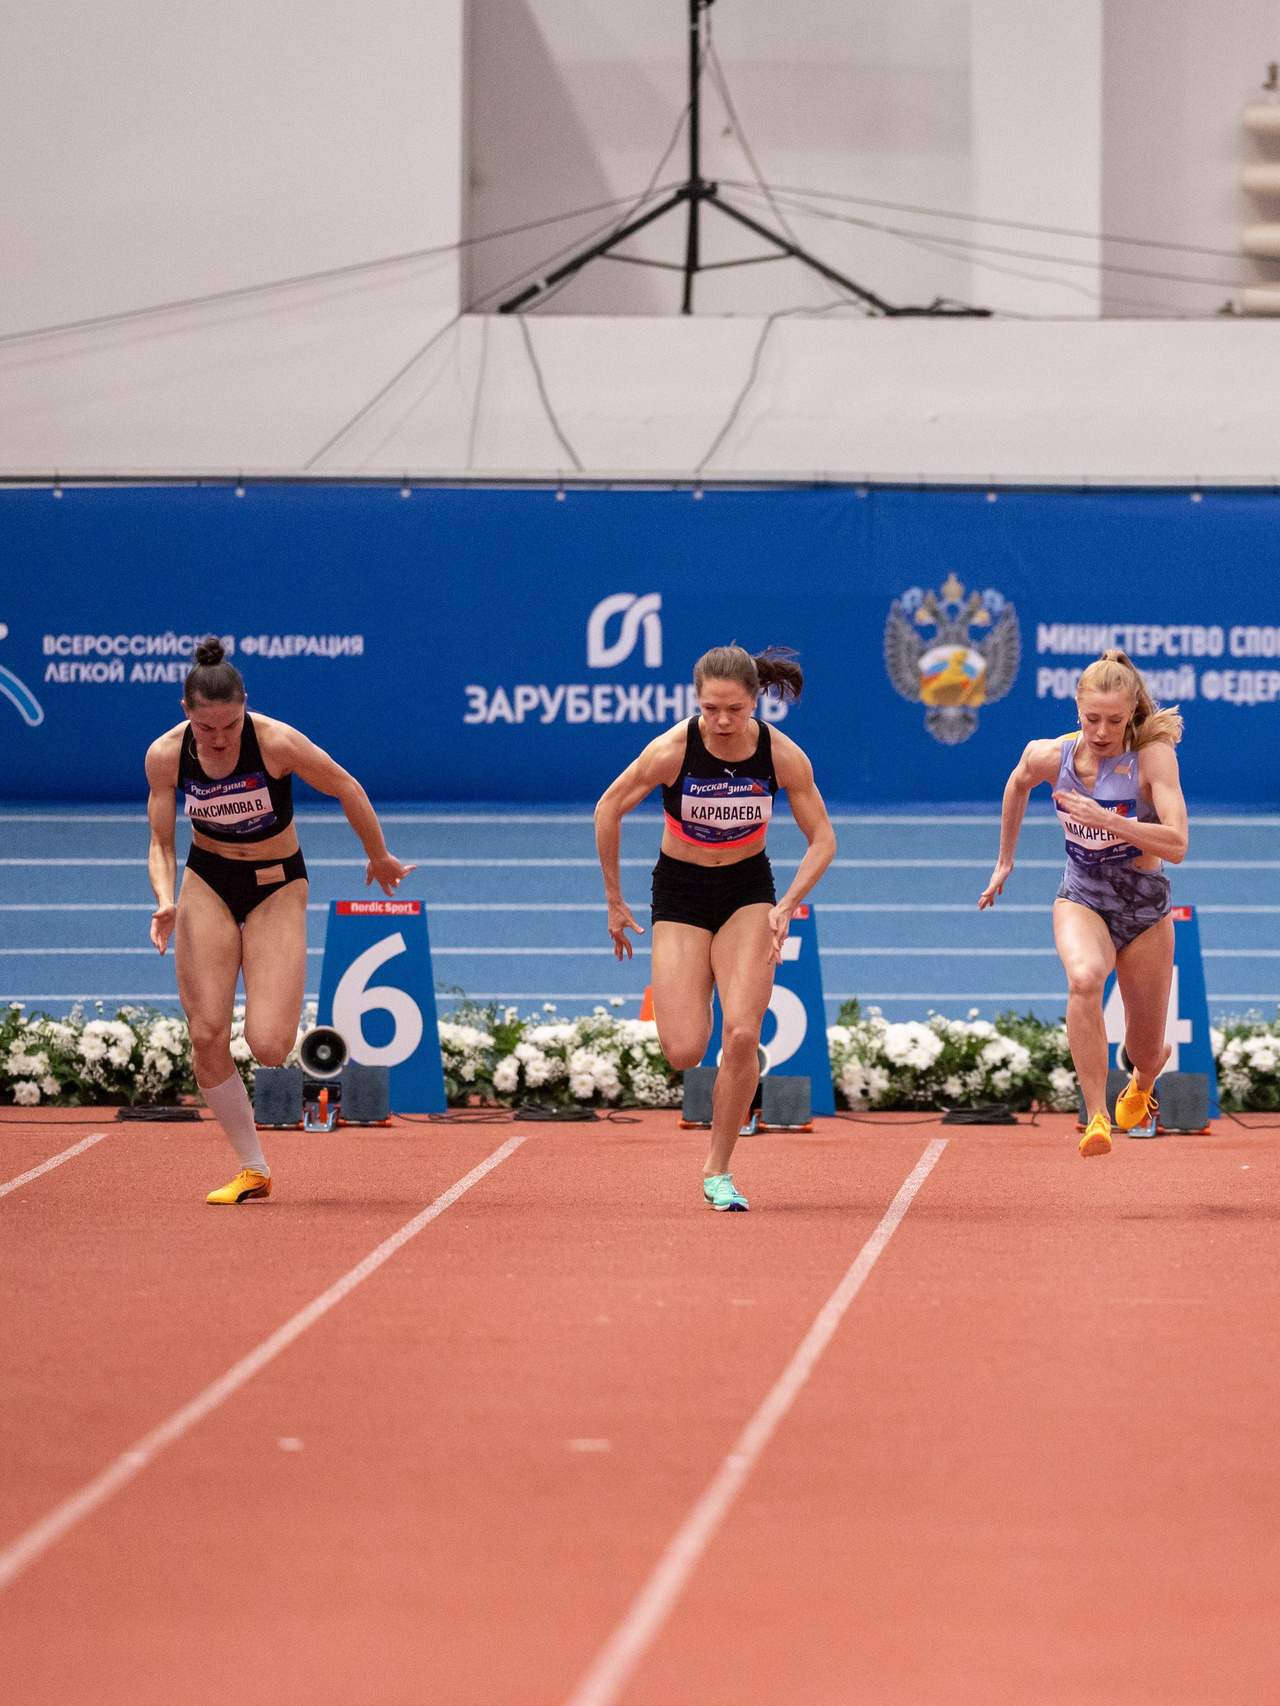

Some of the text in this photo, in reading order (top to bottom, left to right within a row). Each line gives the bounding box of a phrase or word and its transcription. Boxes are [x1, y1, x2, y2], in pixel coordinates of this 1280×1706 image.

[43, 630, 364, 659] ВСЕРОССИЙСЯ ФЕДЕРАЦИЯ
[1036, 624, 1224, 657] МИНИСТЕРСТВО
[44, 658, 125, 683] ЛЕГКОЙ
[1037, 664, 1196, 701] РОСКОЙ
[464, 684, 789, 723] ЗАРУБЕЖНЕЬ
[690, 782, 728, 794] Русская
[188, 798, 267, 818] МАКСИМОВА В.
[691, 805, 762, 821] КАРАВАЕВА
[1064, 821, 1119, 841] МАКАРЕН
[332, 931, 424, 1067] 6
